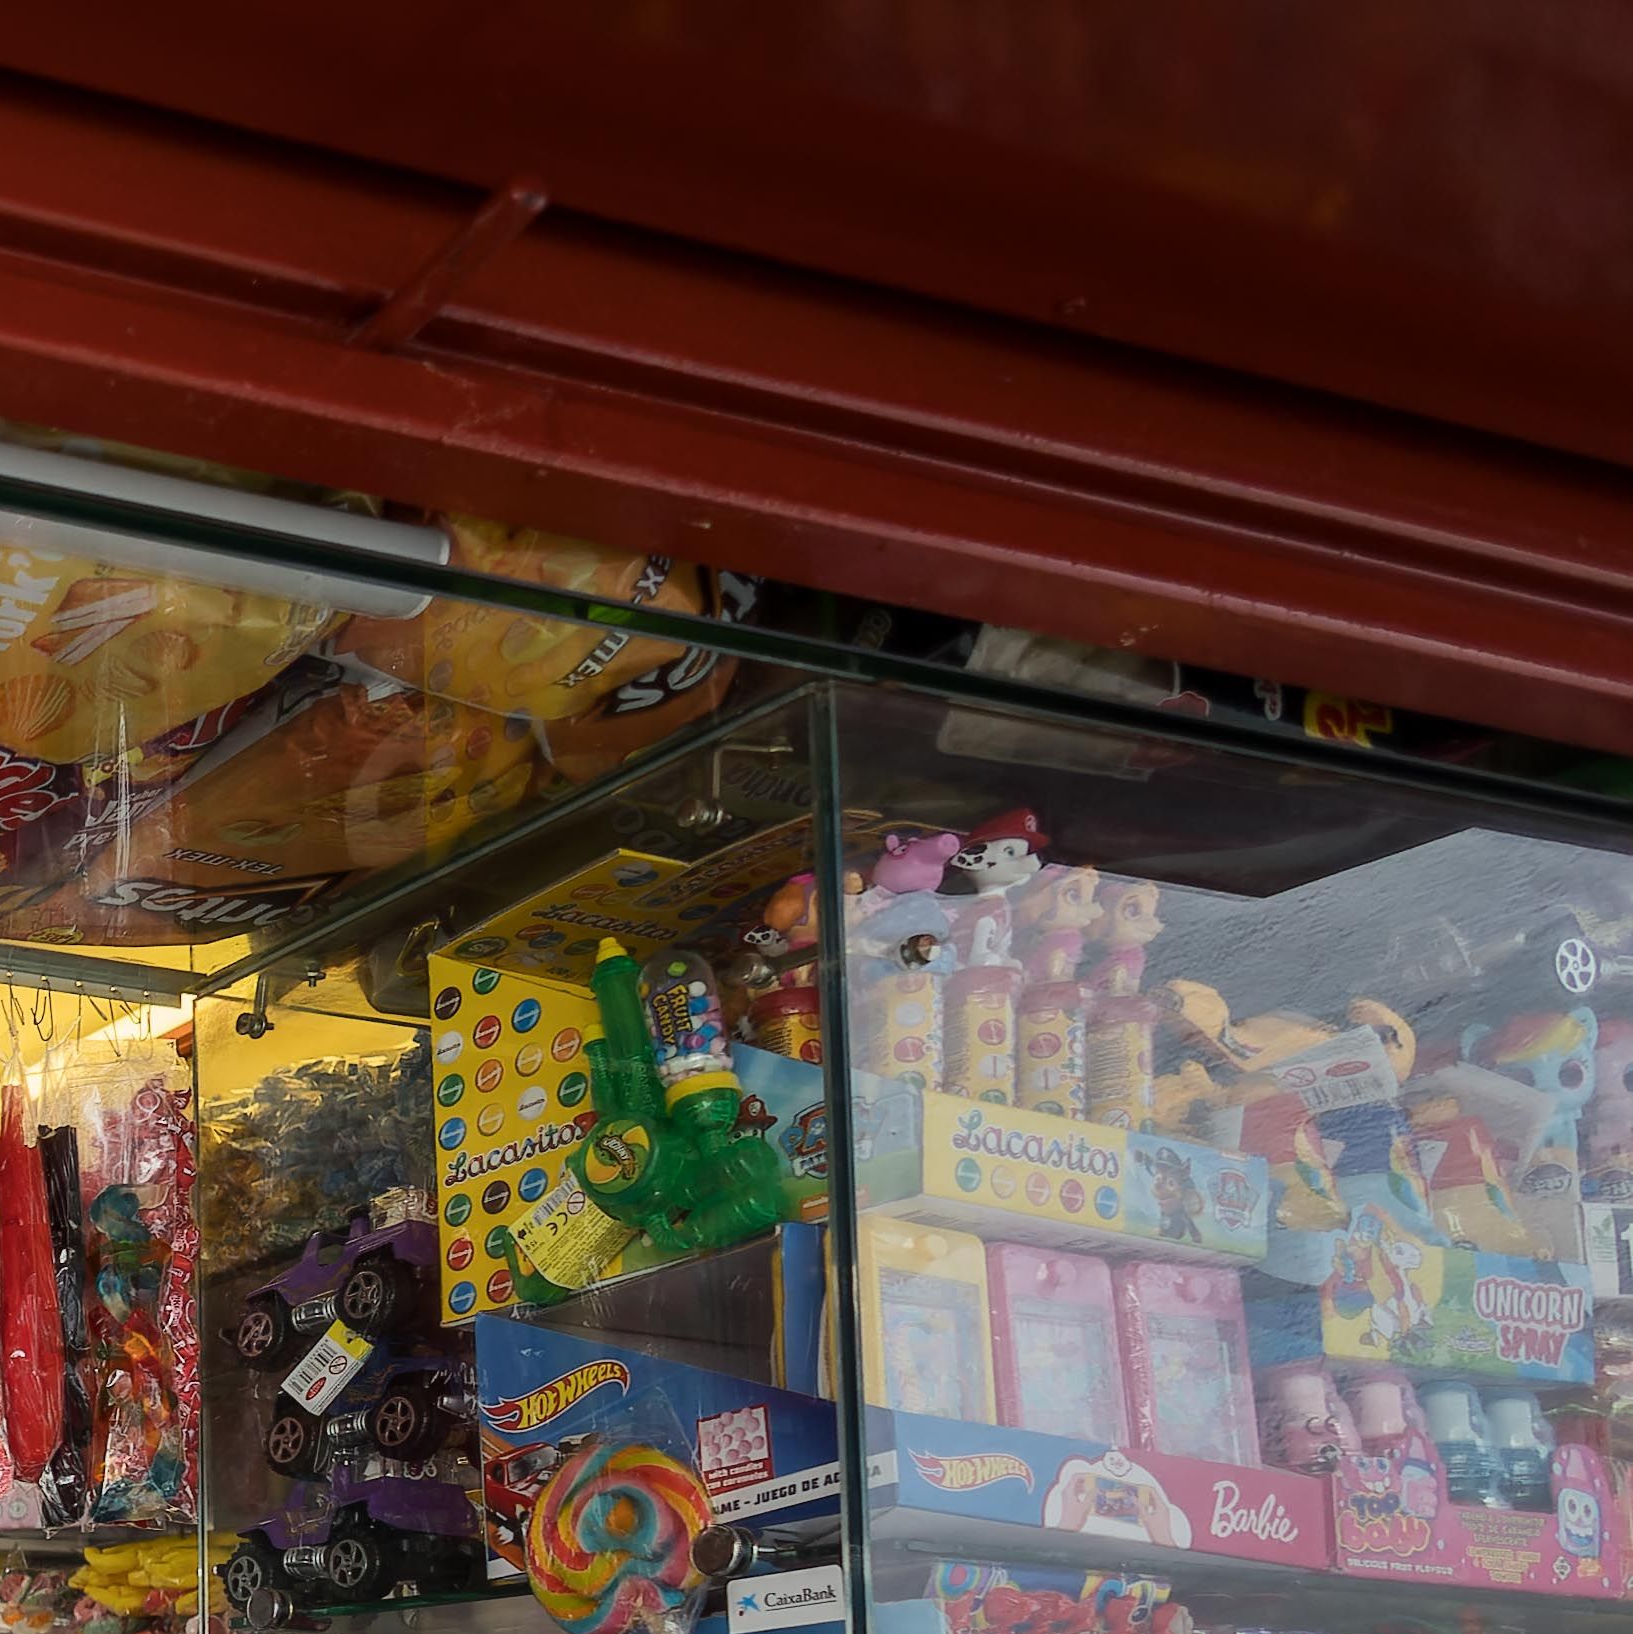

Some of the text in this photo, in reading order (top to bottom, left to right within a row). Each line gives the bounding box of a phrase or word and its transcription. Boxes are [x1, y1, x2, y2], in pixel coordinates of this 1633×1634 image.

[649, 991, 676, 1047] CANDY
[666, 983, 691, 1035] FRUIT
[444, 1119, 585, 1188] Lacasitos
[951, 1108, 1120, 1179] Lacasitos
[1478, 1280, 1584, 1329] UNICORN
[554, 1361, 624, 1408] WHEELS
[754, 1478, 820, 1505] JUEGO DE
[1210, 1478, 1299, 1544] Barbie
[764, 1585, 837, 1607] CaixaBank
